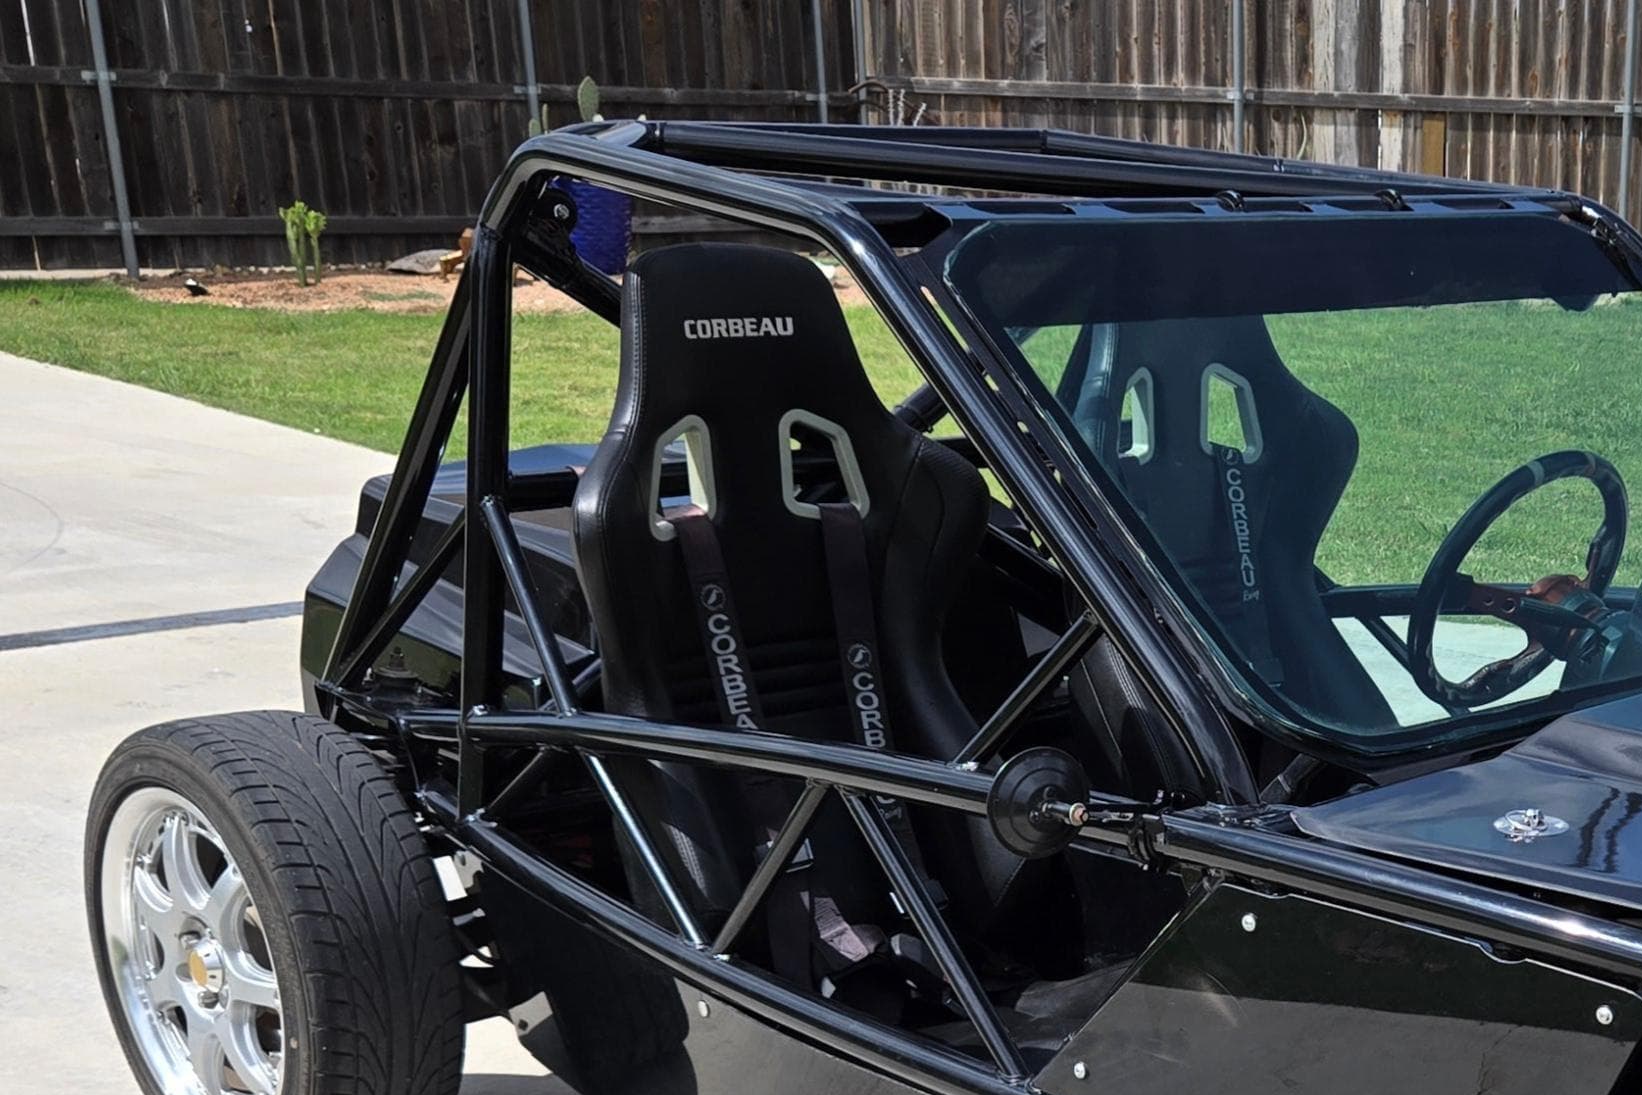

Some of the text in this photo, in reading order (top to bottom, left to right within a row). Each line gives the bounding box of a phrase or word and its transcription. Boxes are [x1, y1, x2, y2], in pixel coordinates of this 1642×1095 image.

[683, 316, 794, 339] CORBEAU
[1226, 468, 1255, 588] CORBEAU
[708, 613, 759, 730] CORBEA
[852, 672, 887, 749] CORB
